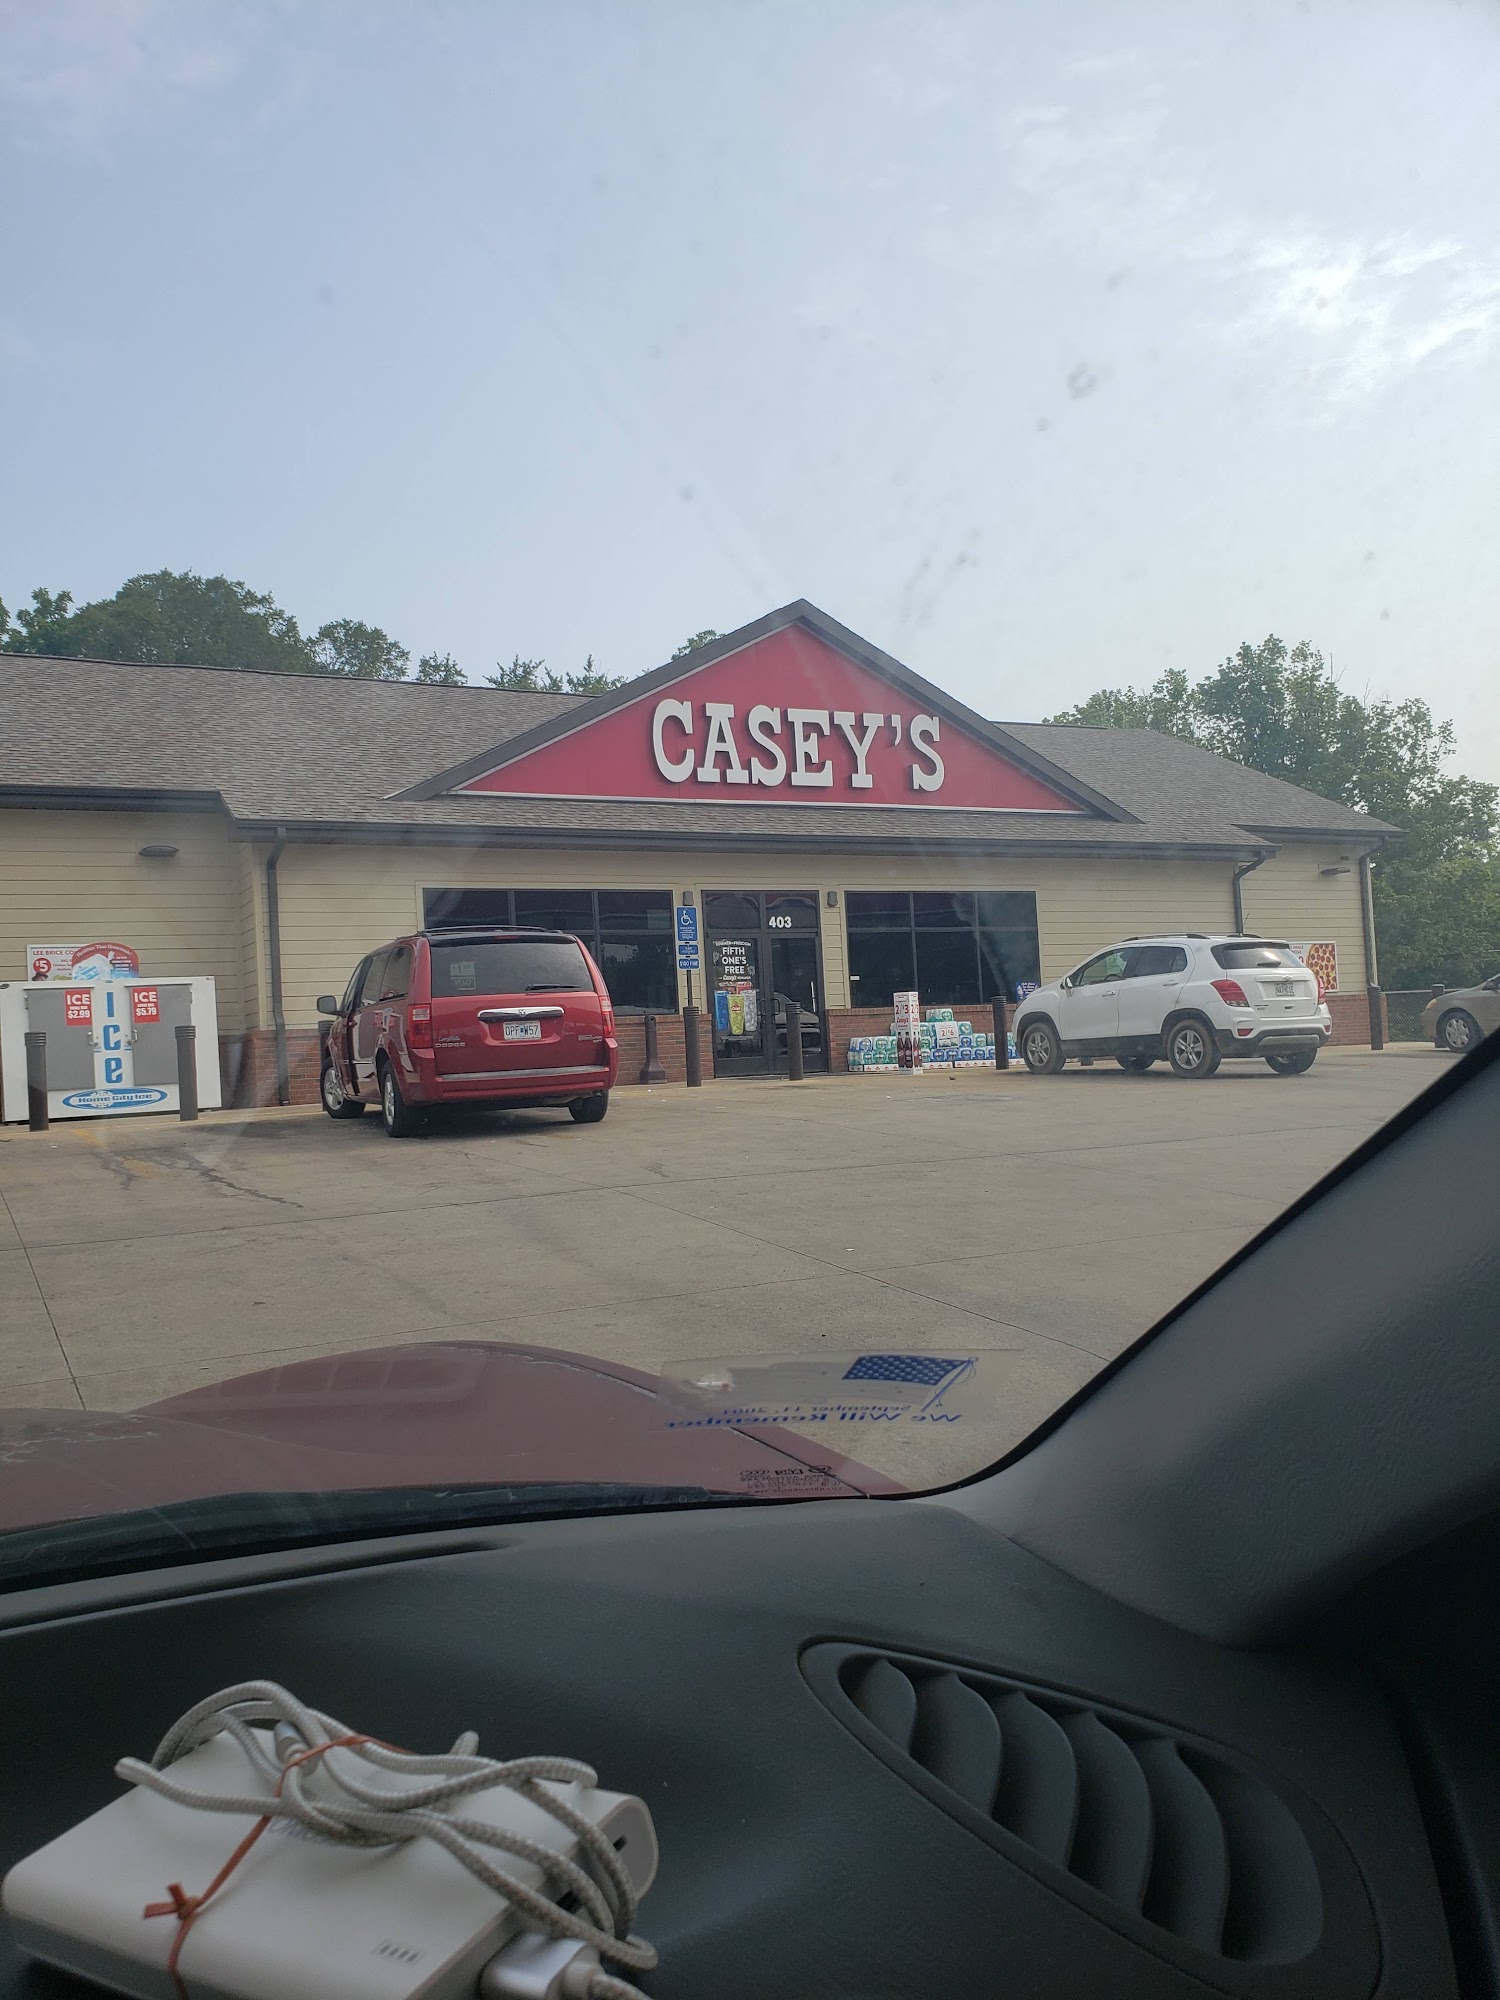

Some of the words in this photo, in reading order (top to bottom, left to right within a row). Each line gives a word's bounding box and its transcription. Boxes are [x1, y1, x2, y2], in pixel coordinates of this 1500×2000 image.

[652, 698, 945, 792] CASEY'S
[769, 916, 792, 928] 403
[722, 947, 745, 955] FIFTH
[721, 956, 747, 965] ONE'S
[725, 966, 745, 974] FREE
[67, 994, 91, 1005] ICE
[134, 991, 158, 1003] ICE
[67, 1010, 91, 1019] $2.99
[136, 1007, 157, 1017] $5.79
